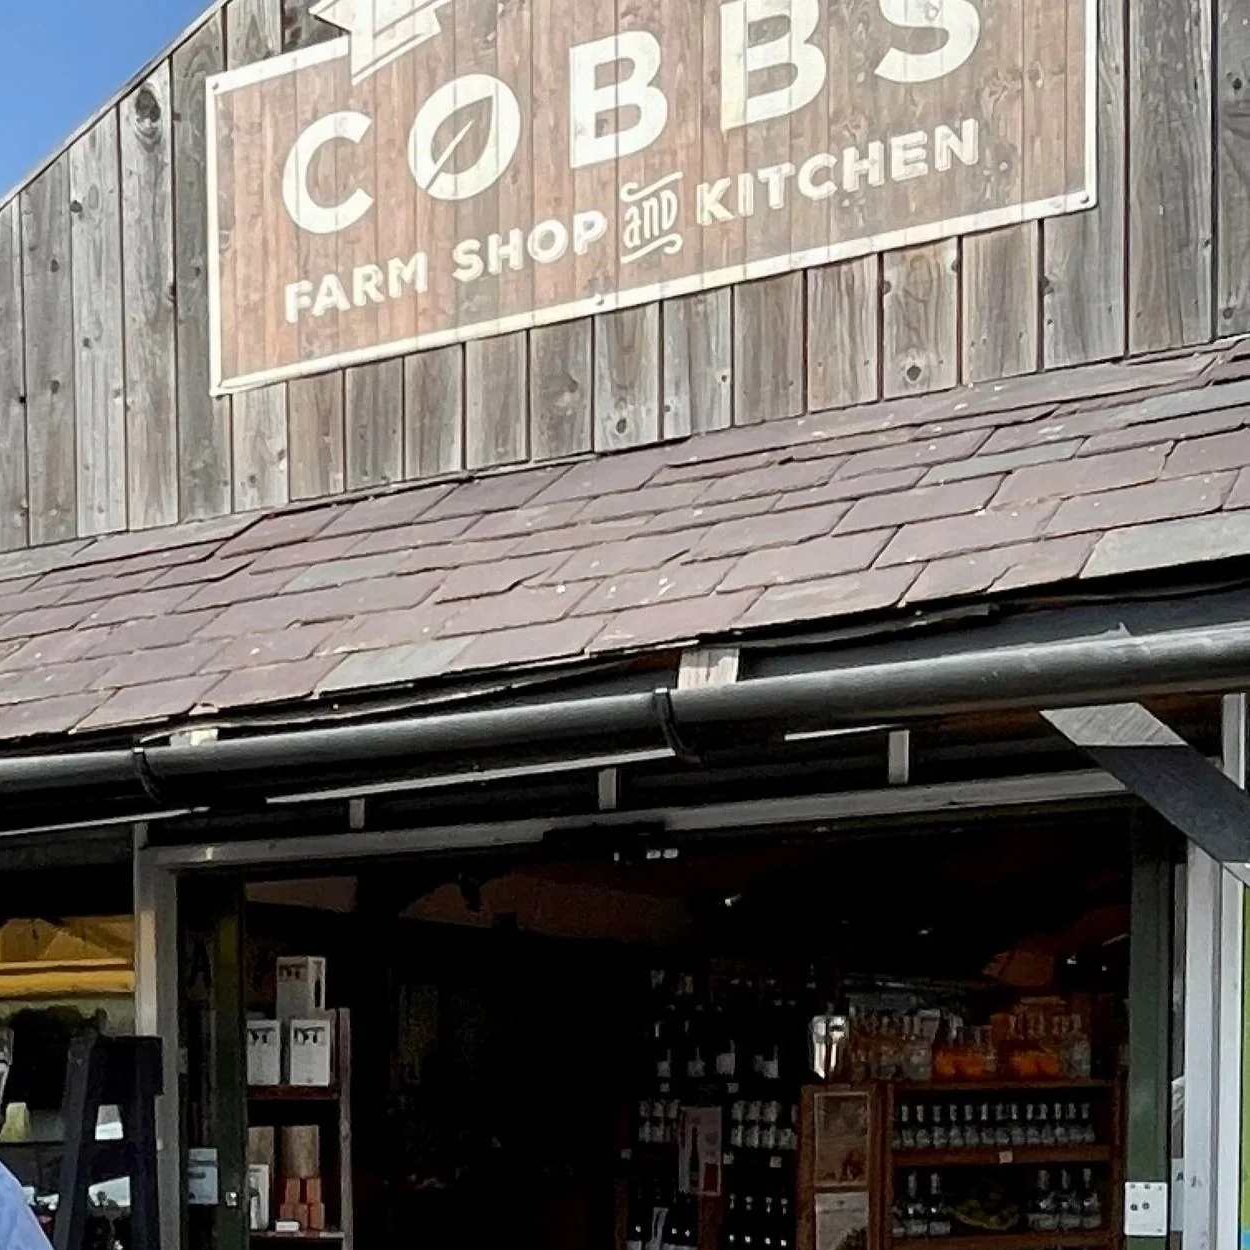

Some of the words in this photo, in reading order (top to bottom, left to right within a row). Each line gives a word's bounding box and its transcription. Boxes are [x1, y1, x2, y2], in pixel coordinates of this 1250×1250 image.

[281, 0, 980, 234] COBBS
[285, 251, 427, 323] FARM
[452, 209, 607, 284] SHOP
[695, 118, 980, 227] KITCHEN
